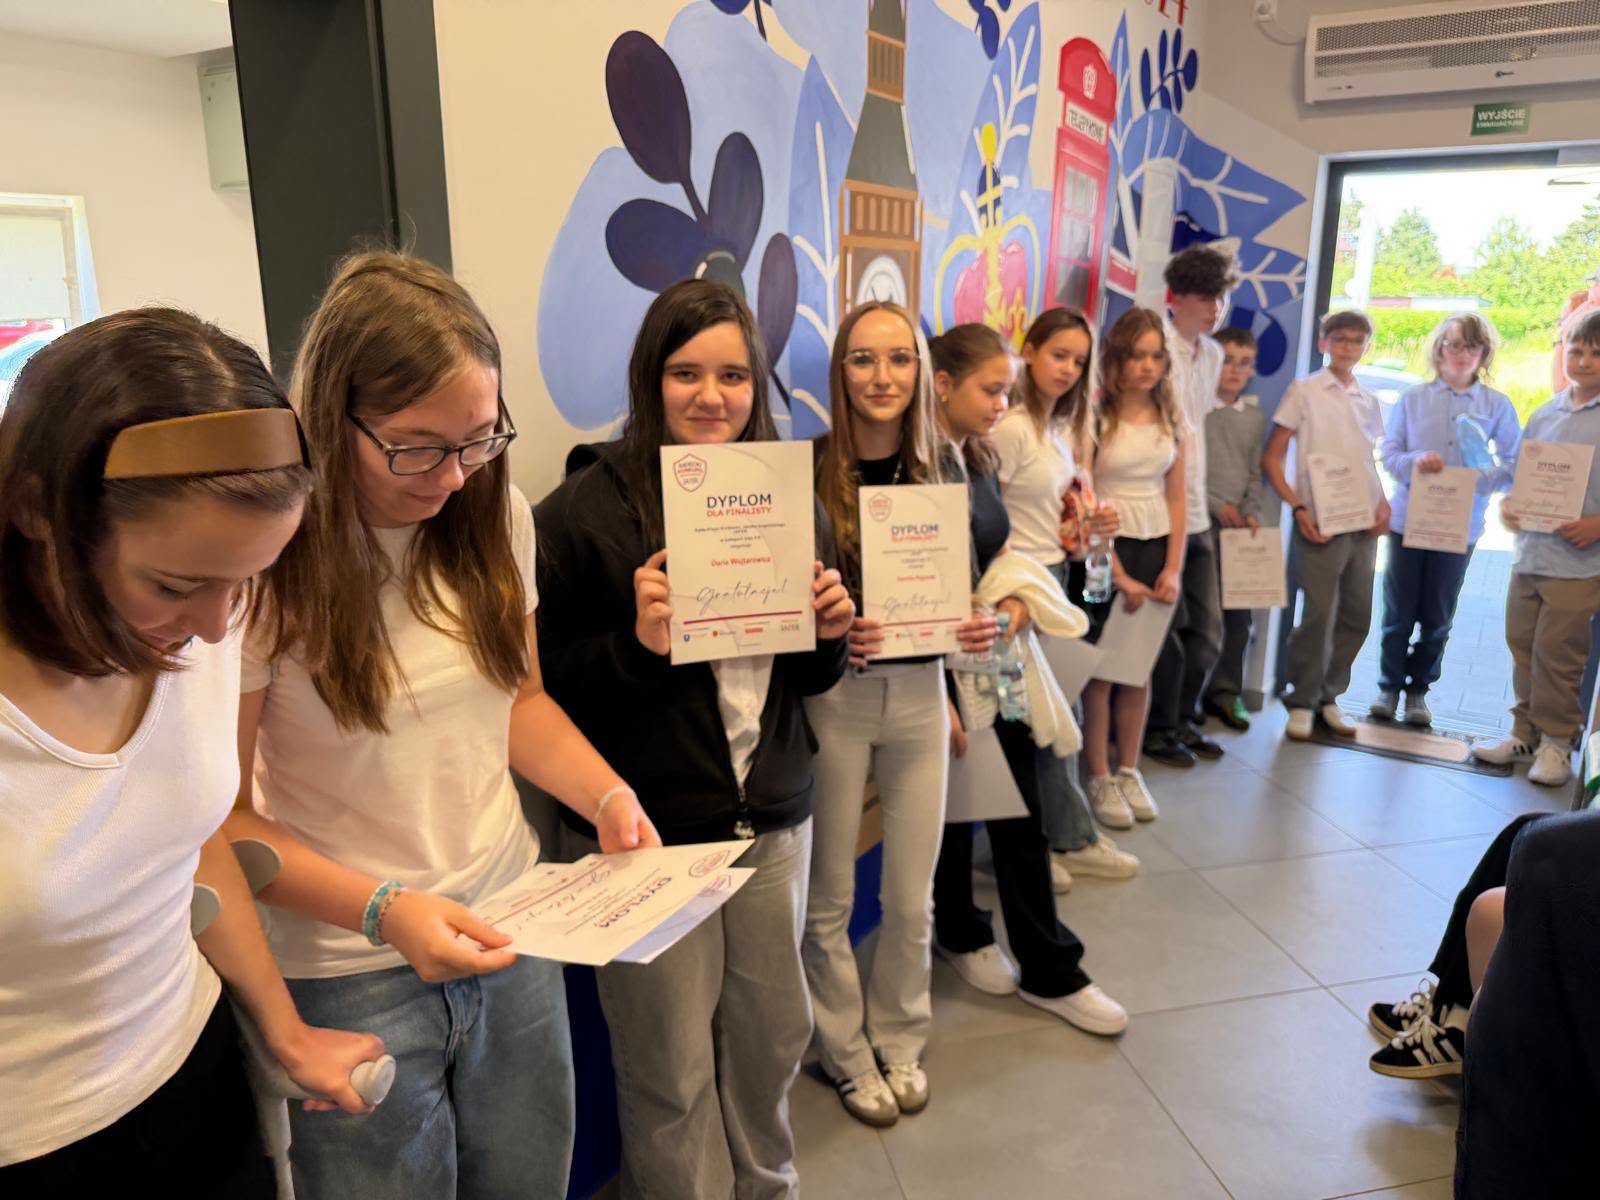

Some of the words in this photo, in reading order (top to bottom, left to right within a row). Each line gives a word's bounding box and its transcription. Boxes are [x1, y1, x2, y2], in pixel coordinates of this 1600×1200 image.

[1478, 108, 1525, 120] WYJŚCIE
[707, 494, 772, 508] DYPLOM
[706, 509, 725, 518] DLA
[726, 507, 771, 517] FINALISTY
[892, 525, 938, 535] DYPLOM
[598, 876, 672, 928] DYPLOM
